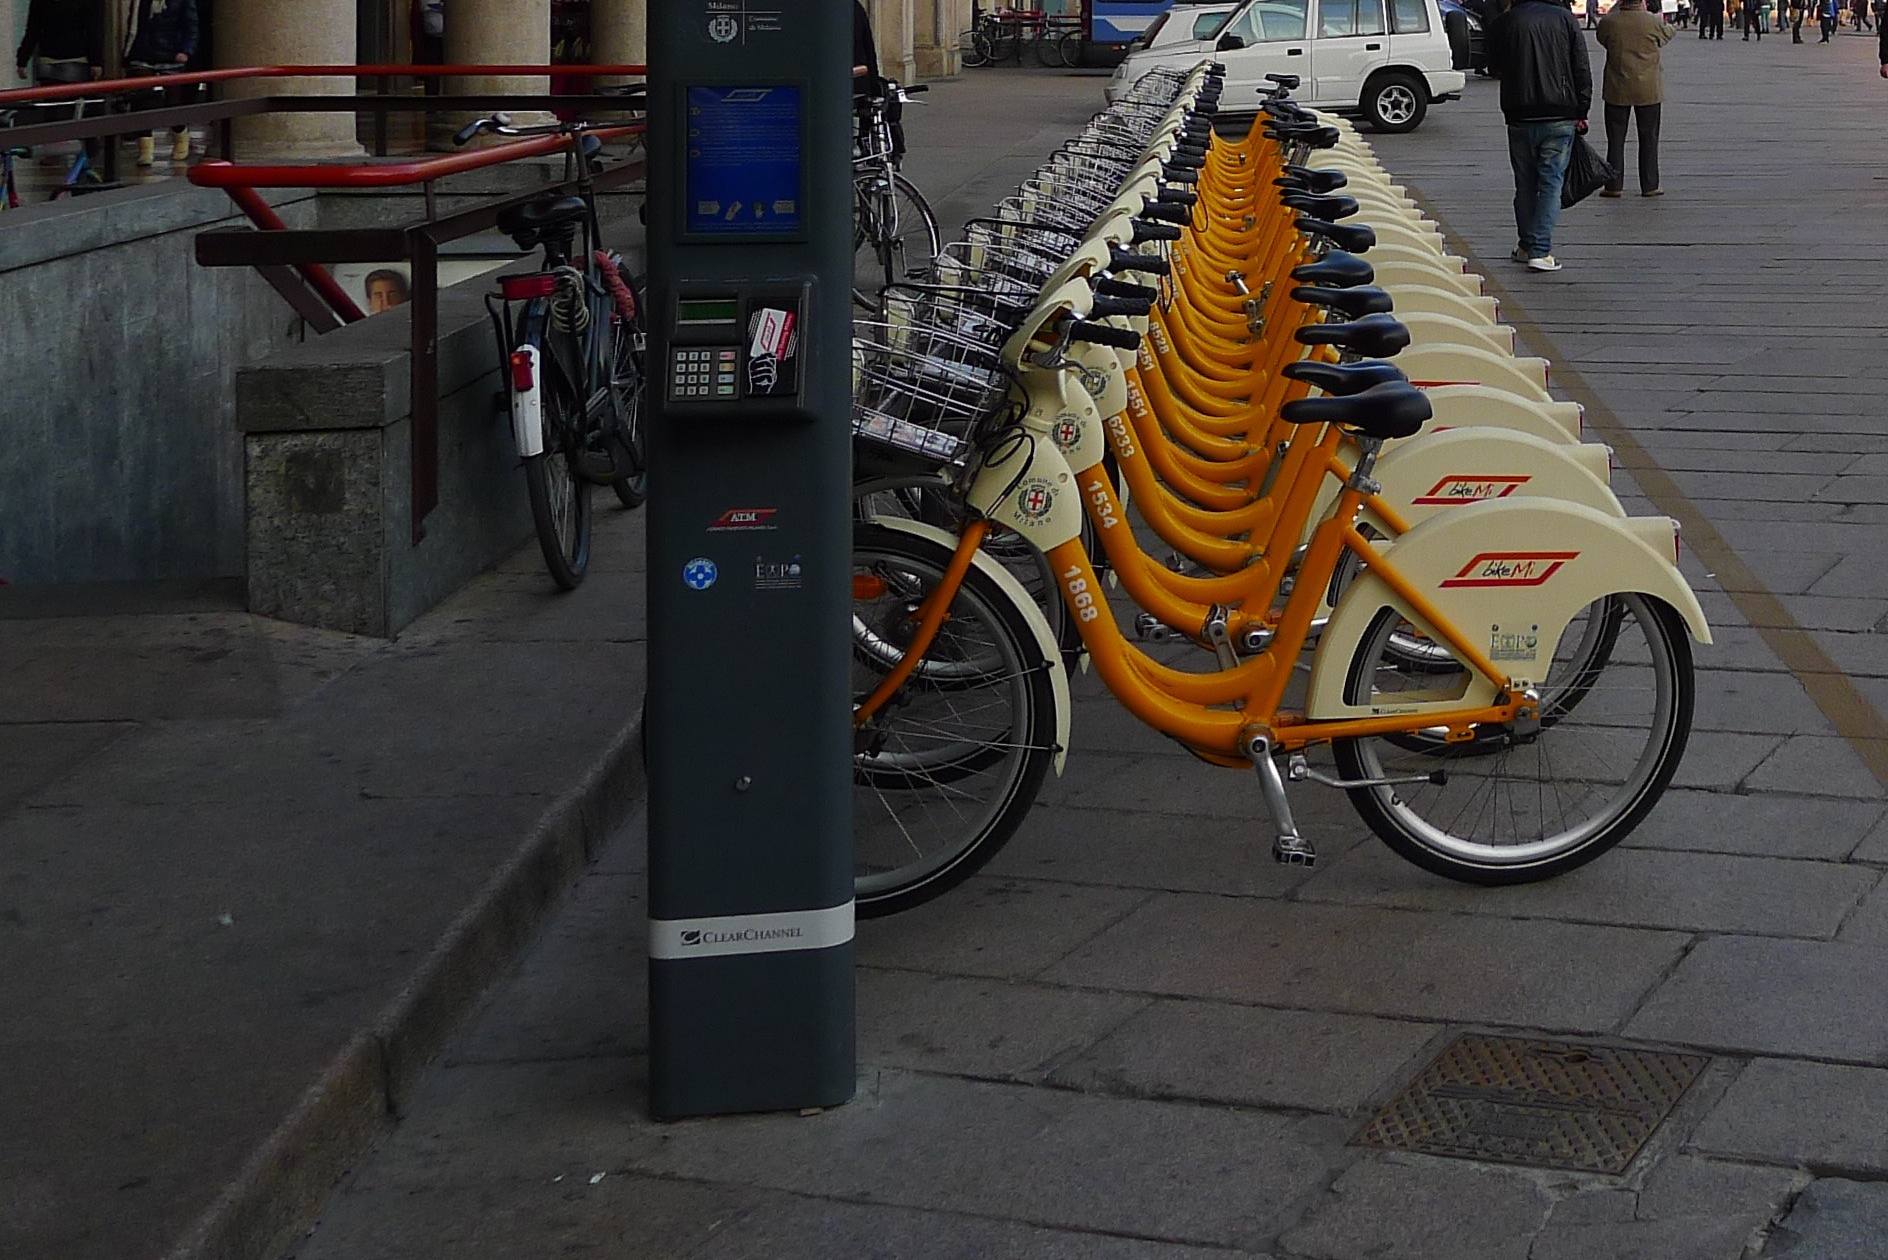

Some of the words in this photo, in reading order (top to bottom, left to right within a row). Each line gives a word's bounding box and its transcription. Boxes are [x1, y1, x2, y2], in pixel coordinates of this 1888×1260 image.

[1150, 321, 1170, 355] 8528
[1127, 380, 1148, 418] 1551
[1108, 415, 1135, 459] 6233
[1086, 480, 1119, 530] 1534
[1448, 481, 1496, 498] bikeMi
[730, 512, 757, 522] ATM
[1482, 560, 1536, 578] bikeMi
[1063, 565, 1098, 623] 1868
